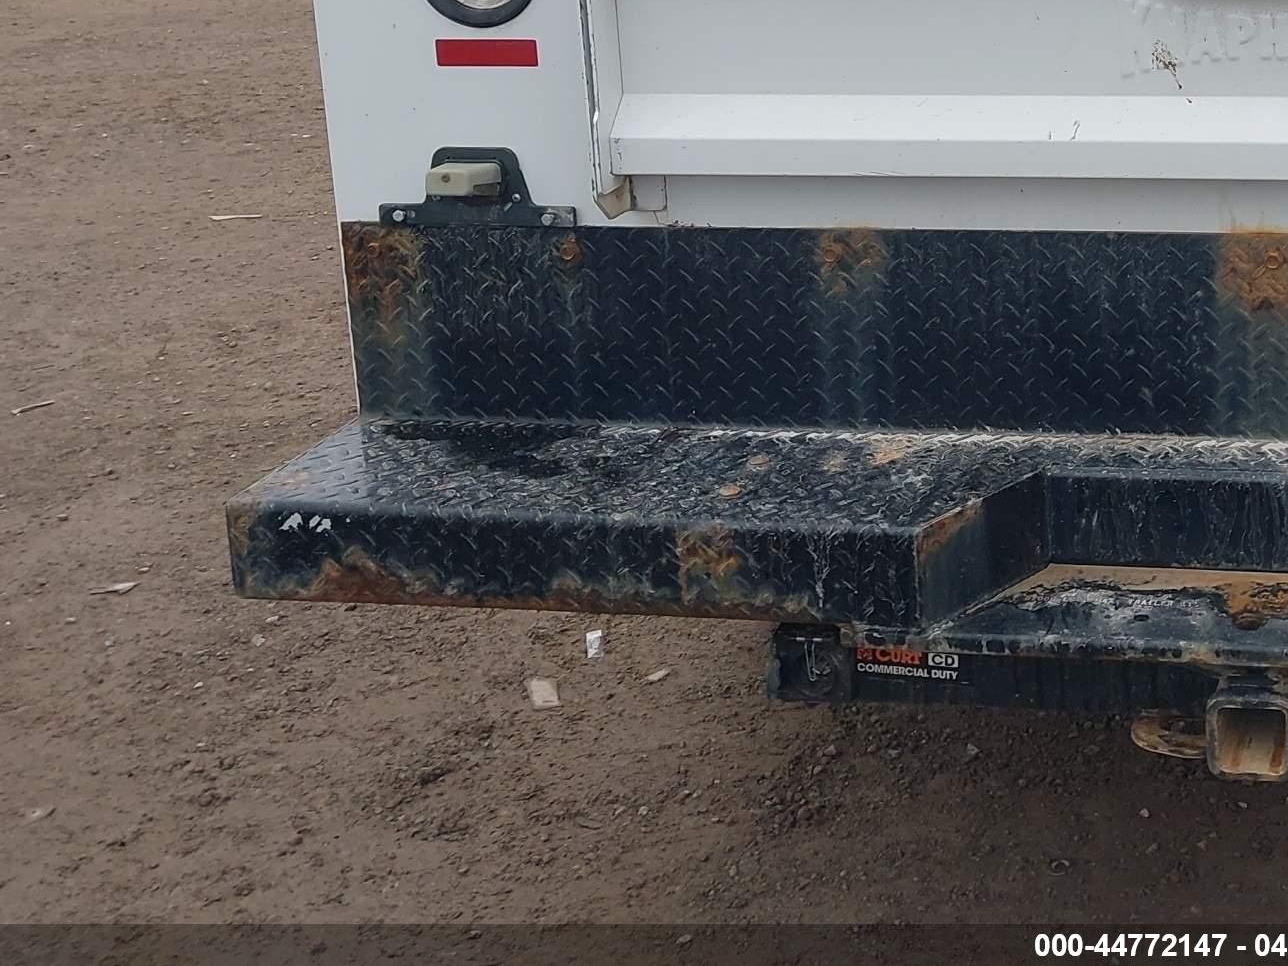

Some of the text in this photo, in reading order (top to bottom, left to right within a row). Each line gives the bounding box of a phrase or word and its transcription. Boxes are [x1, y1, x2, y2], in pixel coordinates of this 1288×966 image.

[875, 648, 956, 667] CURT CD
[857, 663, 958, 680] COMMERCIAL DUTY
